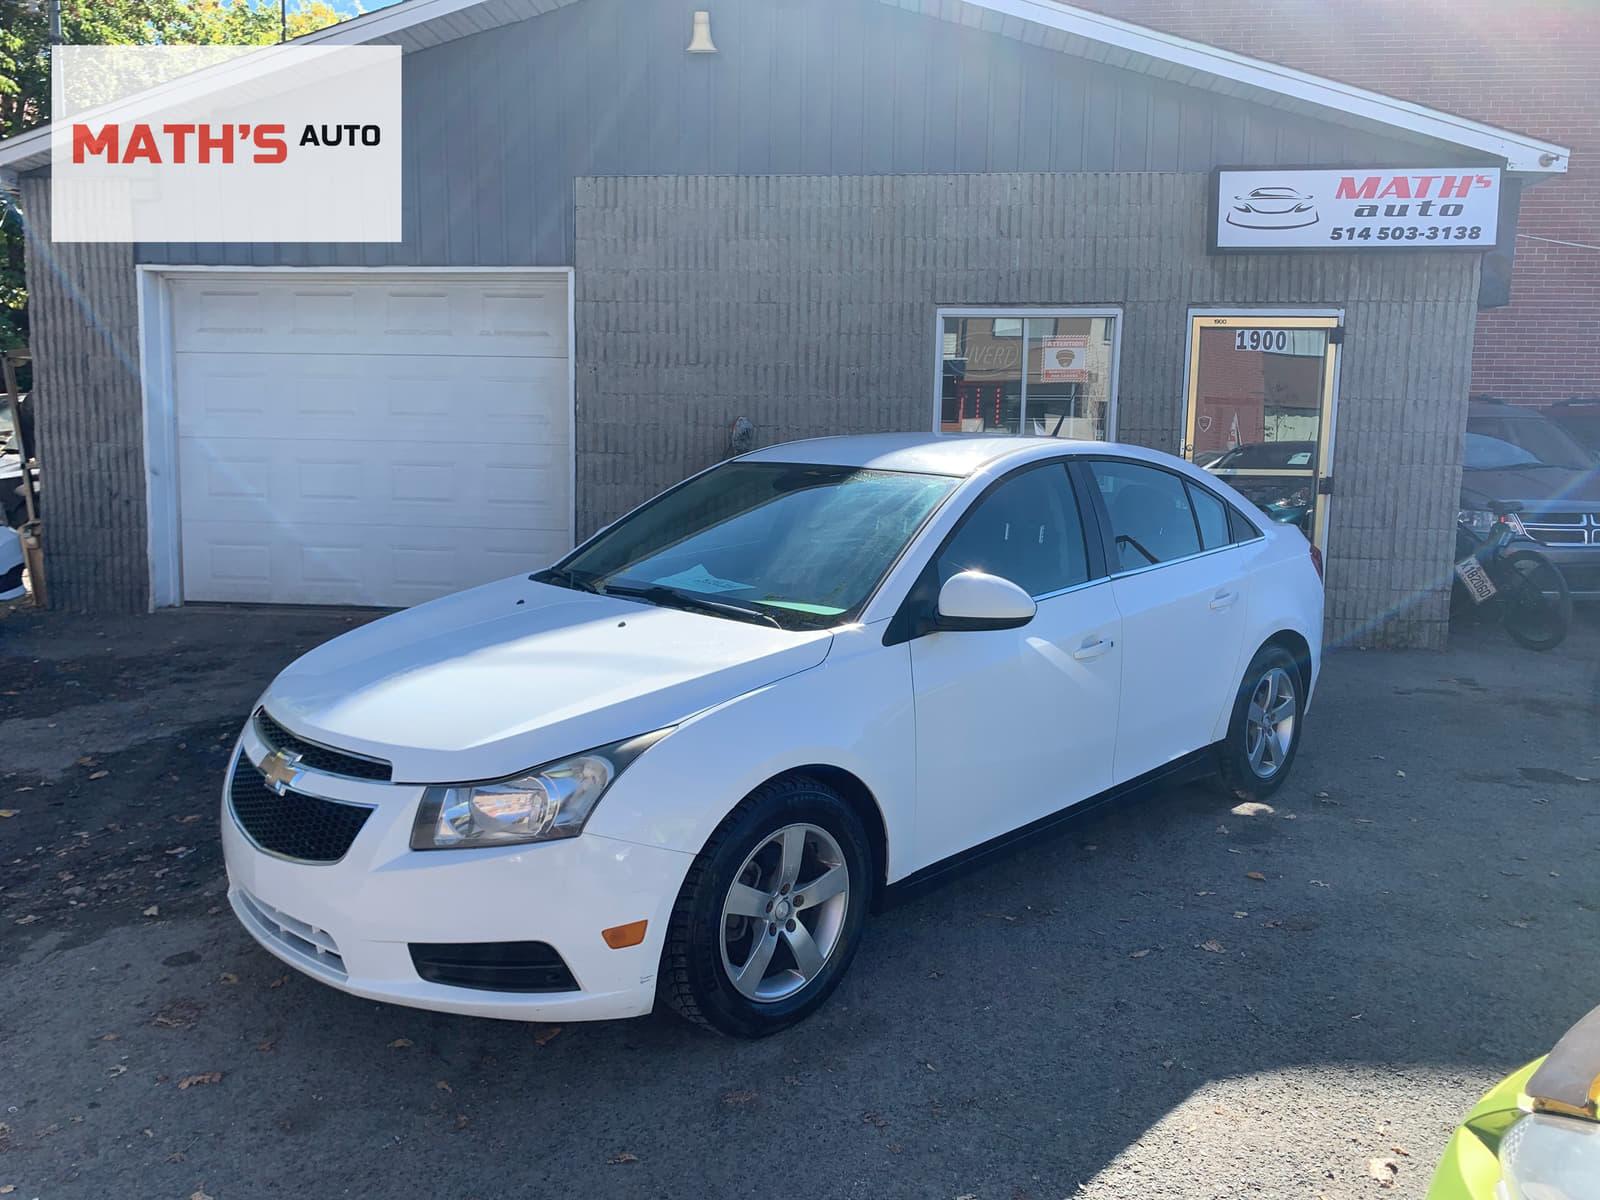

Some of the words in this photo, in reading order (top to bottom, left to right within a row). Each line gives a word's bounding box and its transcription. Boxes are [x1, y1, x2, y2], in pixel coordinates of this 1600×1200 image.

[1354, 200, 1464, 217] auto
[1330, 227, 1371, 241] 514
[1376, 226, 1482, 240] 503-3138
[1236, 330, 1287, 350] 1900
